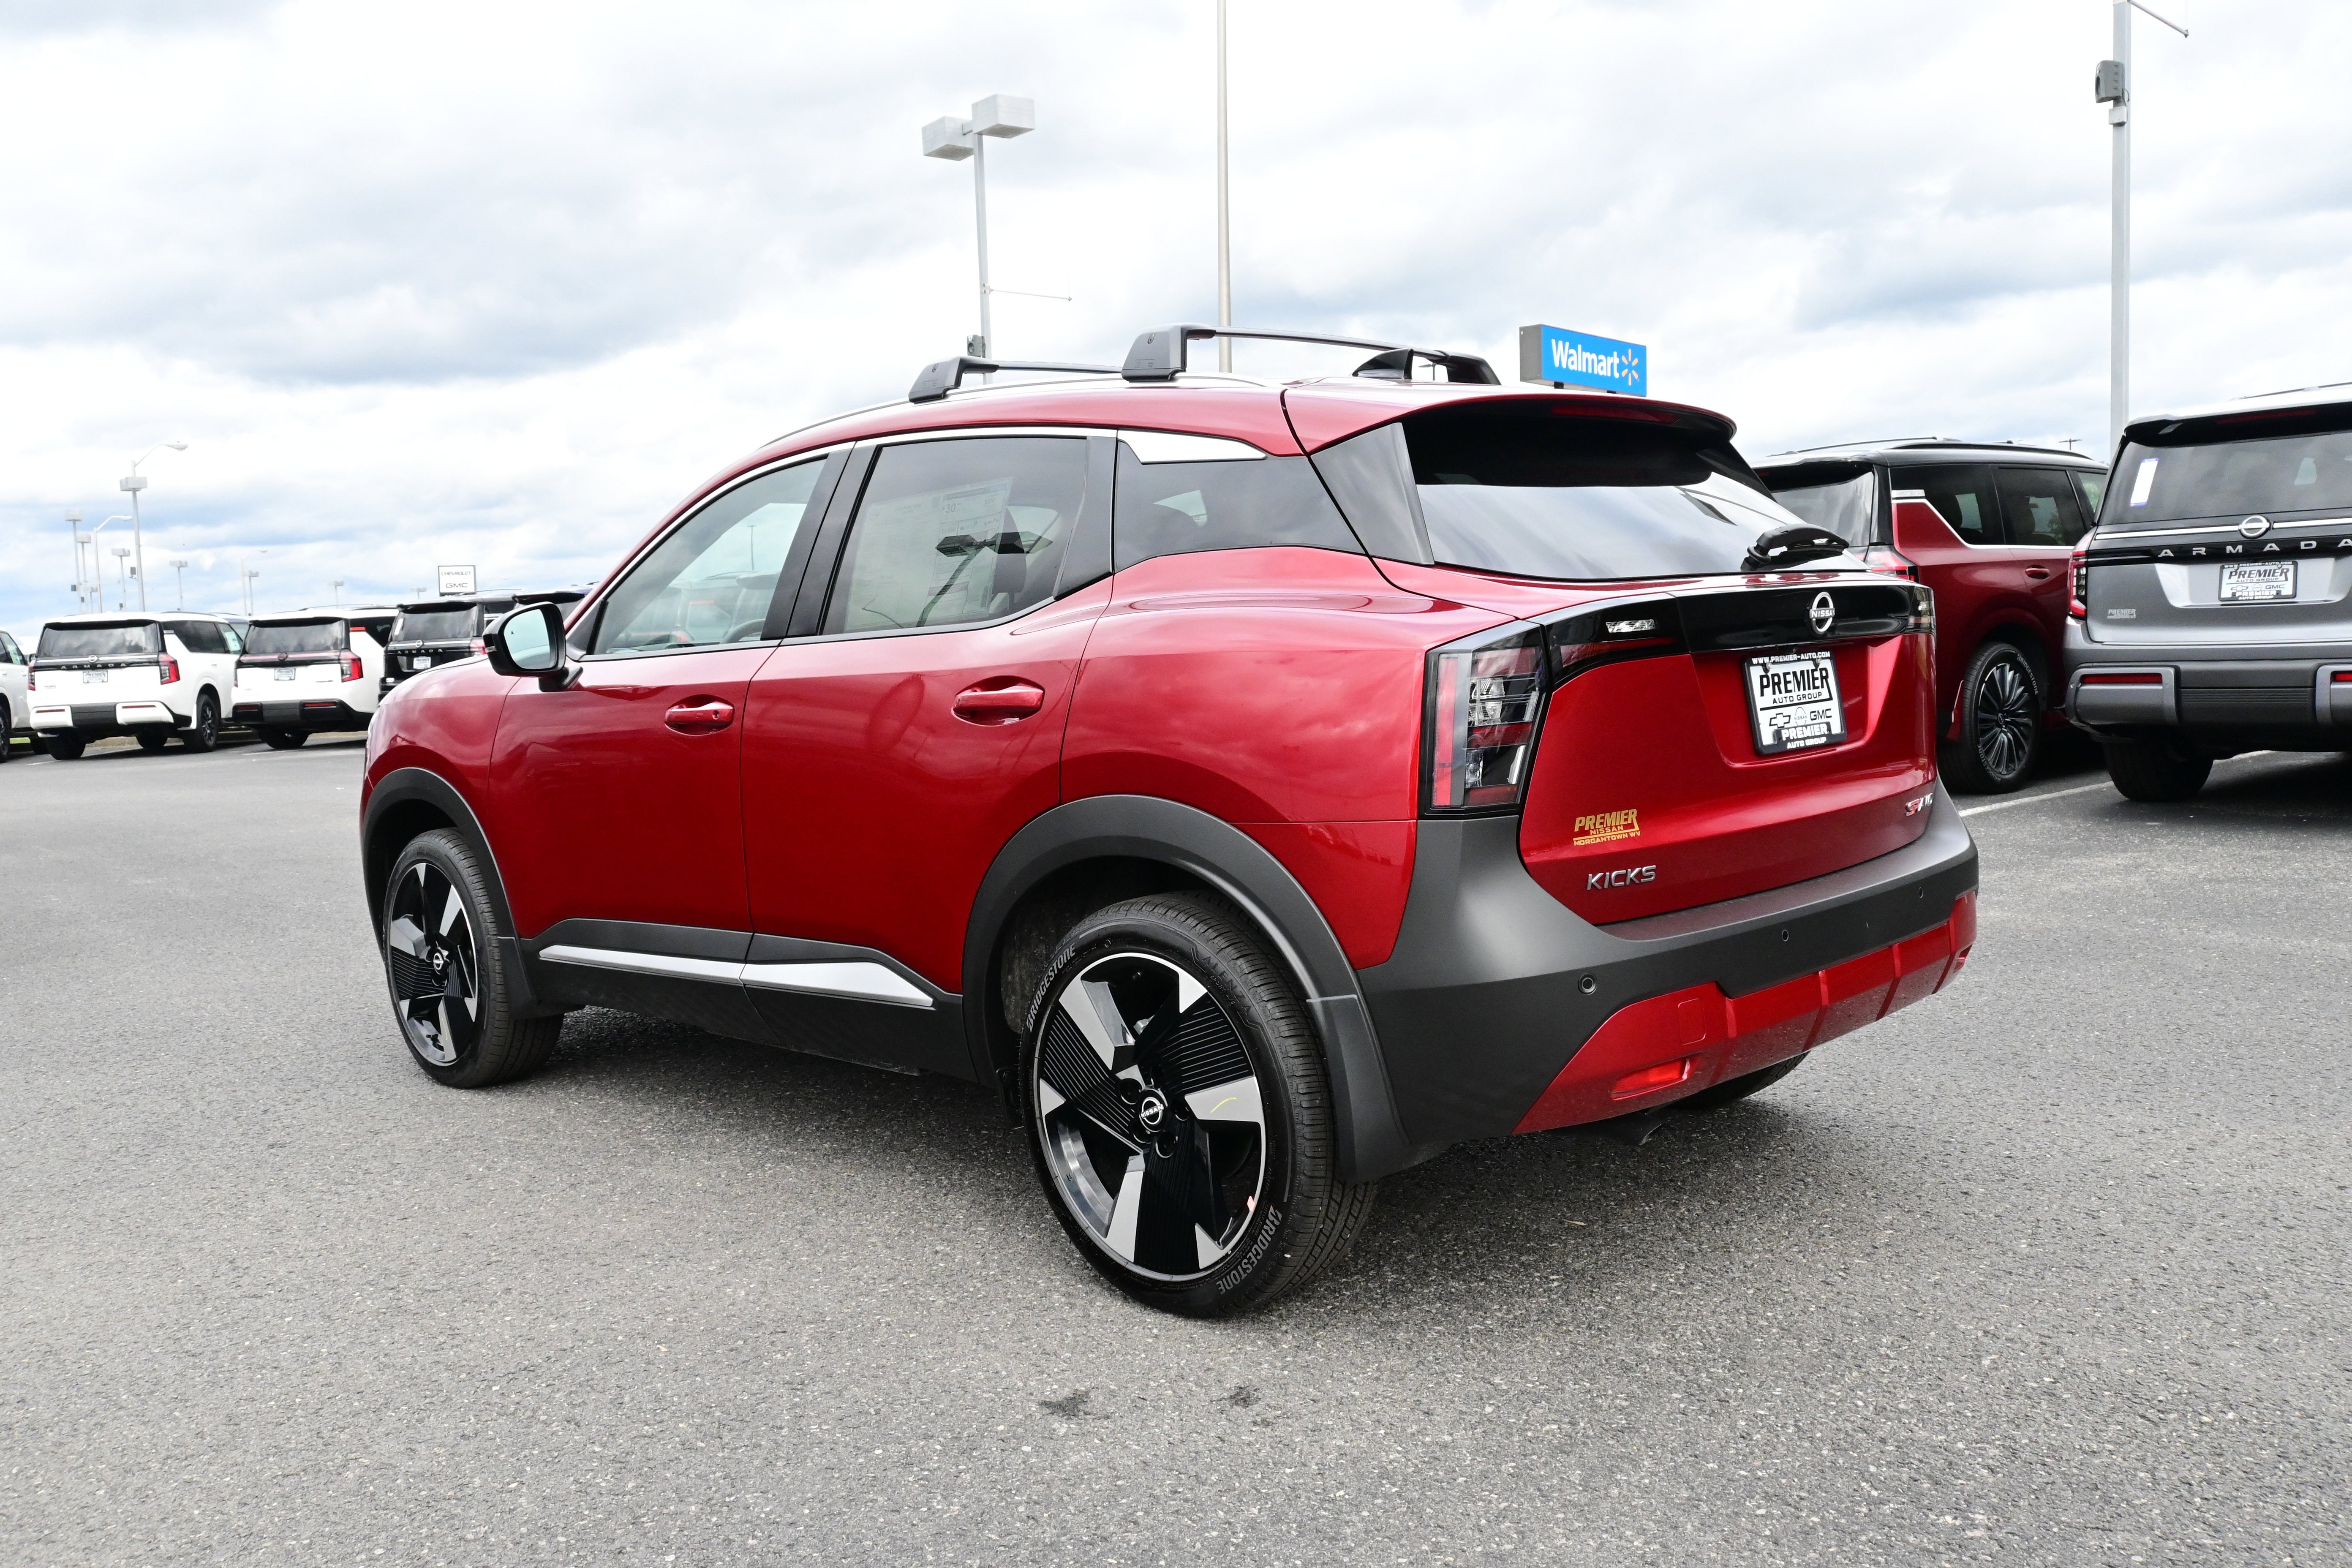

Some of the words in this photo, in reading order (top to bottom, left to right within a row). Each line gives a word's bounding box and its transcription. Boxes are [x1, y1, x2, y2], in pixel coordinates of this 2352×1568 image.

[1552, 339, 1619, 378] Walmart
[2158, 539, 2352, 557] ARMADA
[2228, 568, 2289, 580] PREMIER
[1752, 651, 1830, 664] WWW.PREMIER-AUTO.COM
[1759, 667, 1829, 697] PREMIER
[1772, 696, 1794, 704] AUTO
[1797, 691, 1822, 701] GROUP
[1810, 708, 1832, 721] GMC
[1781, 723, 1828, 741] PREMIER
[1787, 740, 1805, 749] AUTO
[1805, 736, 1827, 746] GROUP
[1574, 808, 1637, 832] PREMIER
[1590, 825, 1624, 835] NISSAN
[1574, 833, 1628, 846] MORGANTOWN
[1587, 865, 1656, 890] KICKS
[1026, 942, 1075, 1033] BRIDGESTONE
[1141, 1105, 1163, 1118] NISSAN
[1216, 1205, 1282, 1294] BRIDGESTONE
